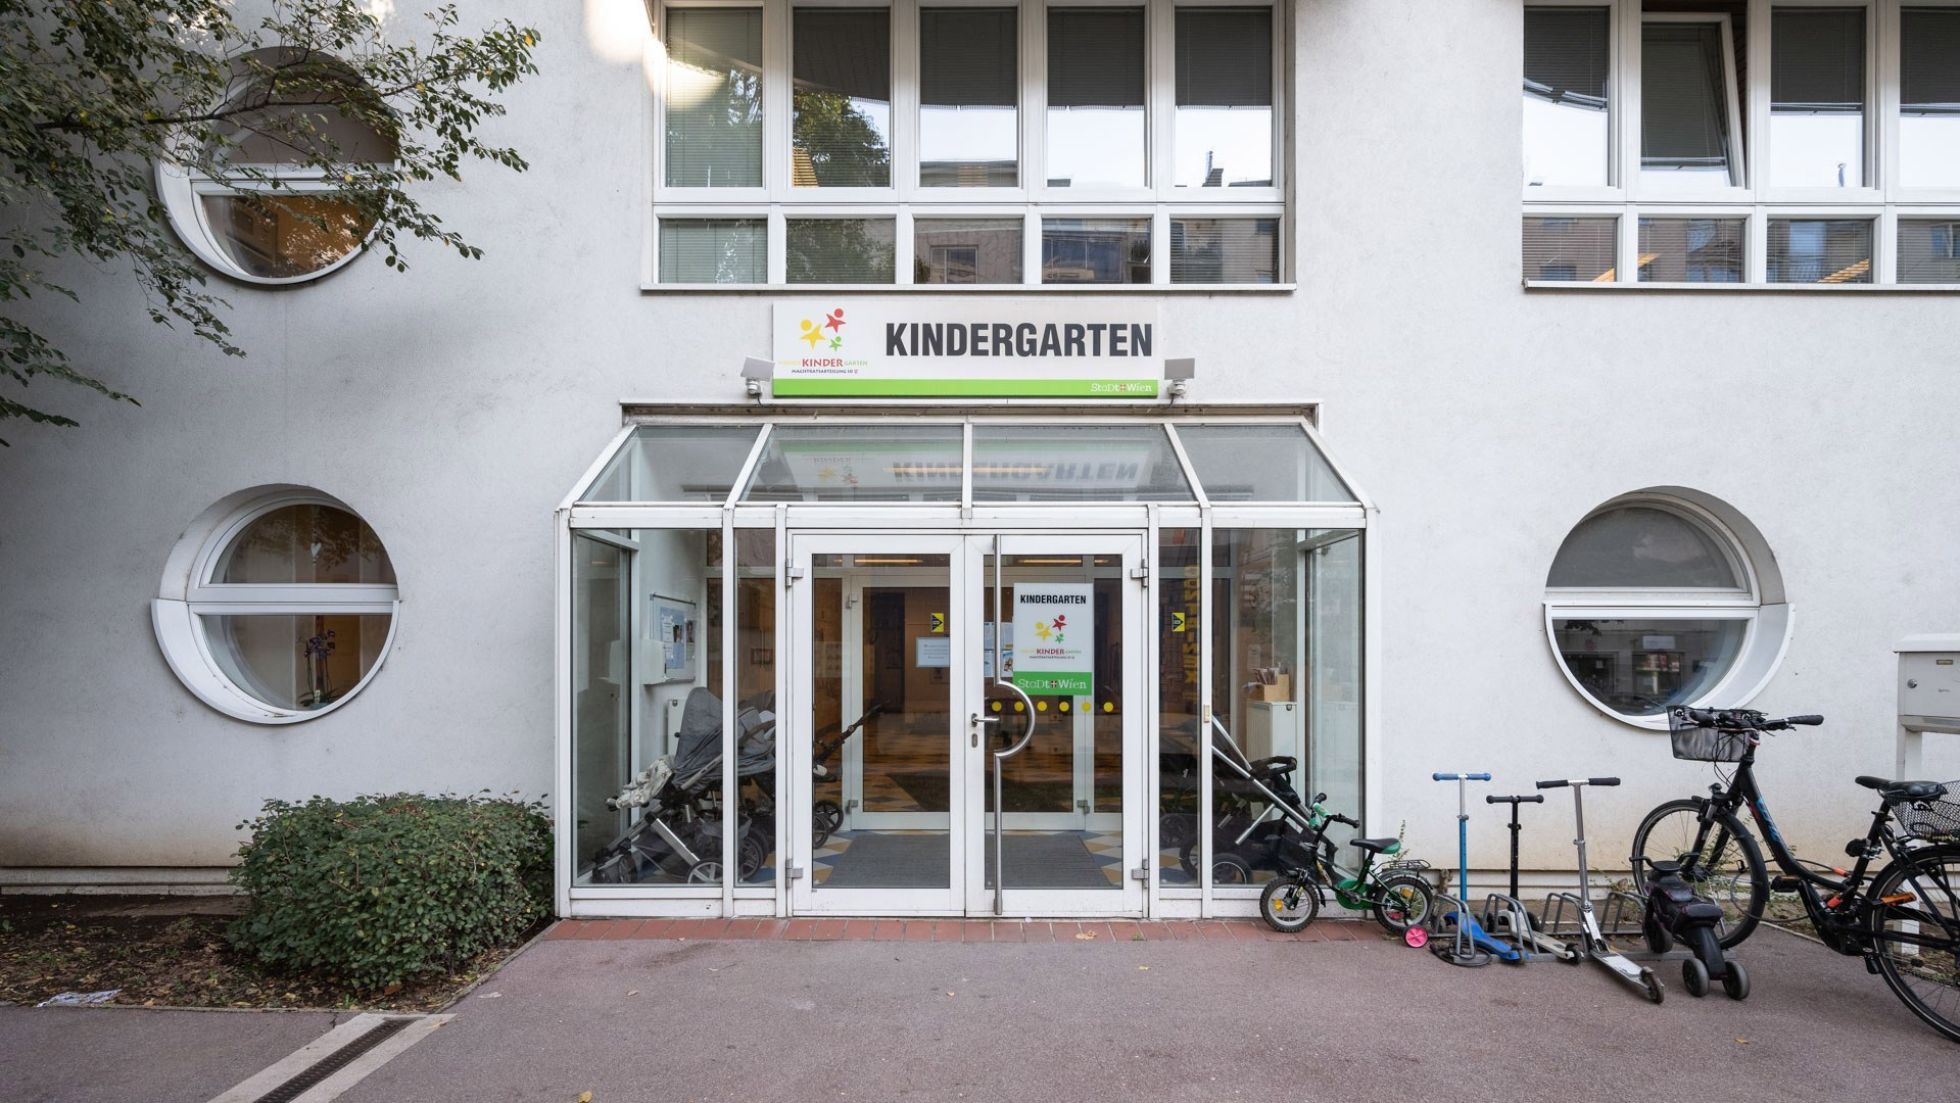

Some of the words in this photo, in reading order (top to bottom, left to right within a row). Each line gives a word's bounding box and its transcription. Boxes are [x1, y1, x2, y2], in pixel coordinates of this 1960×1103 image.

[886, 322, 1152, 357] KINDERGARTEN
[802, 358, 843, 367] KINDER
[1126, 383, 1152, 392] Wien
[1020, 594, 1086, 604] KINDERGARTEN
[1058, 678, 1087, 689] Wien
